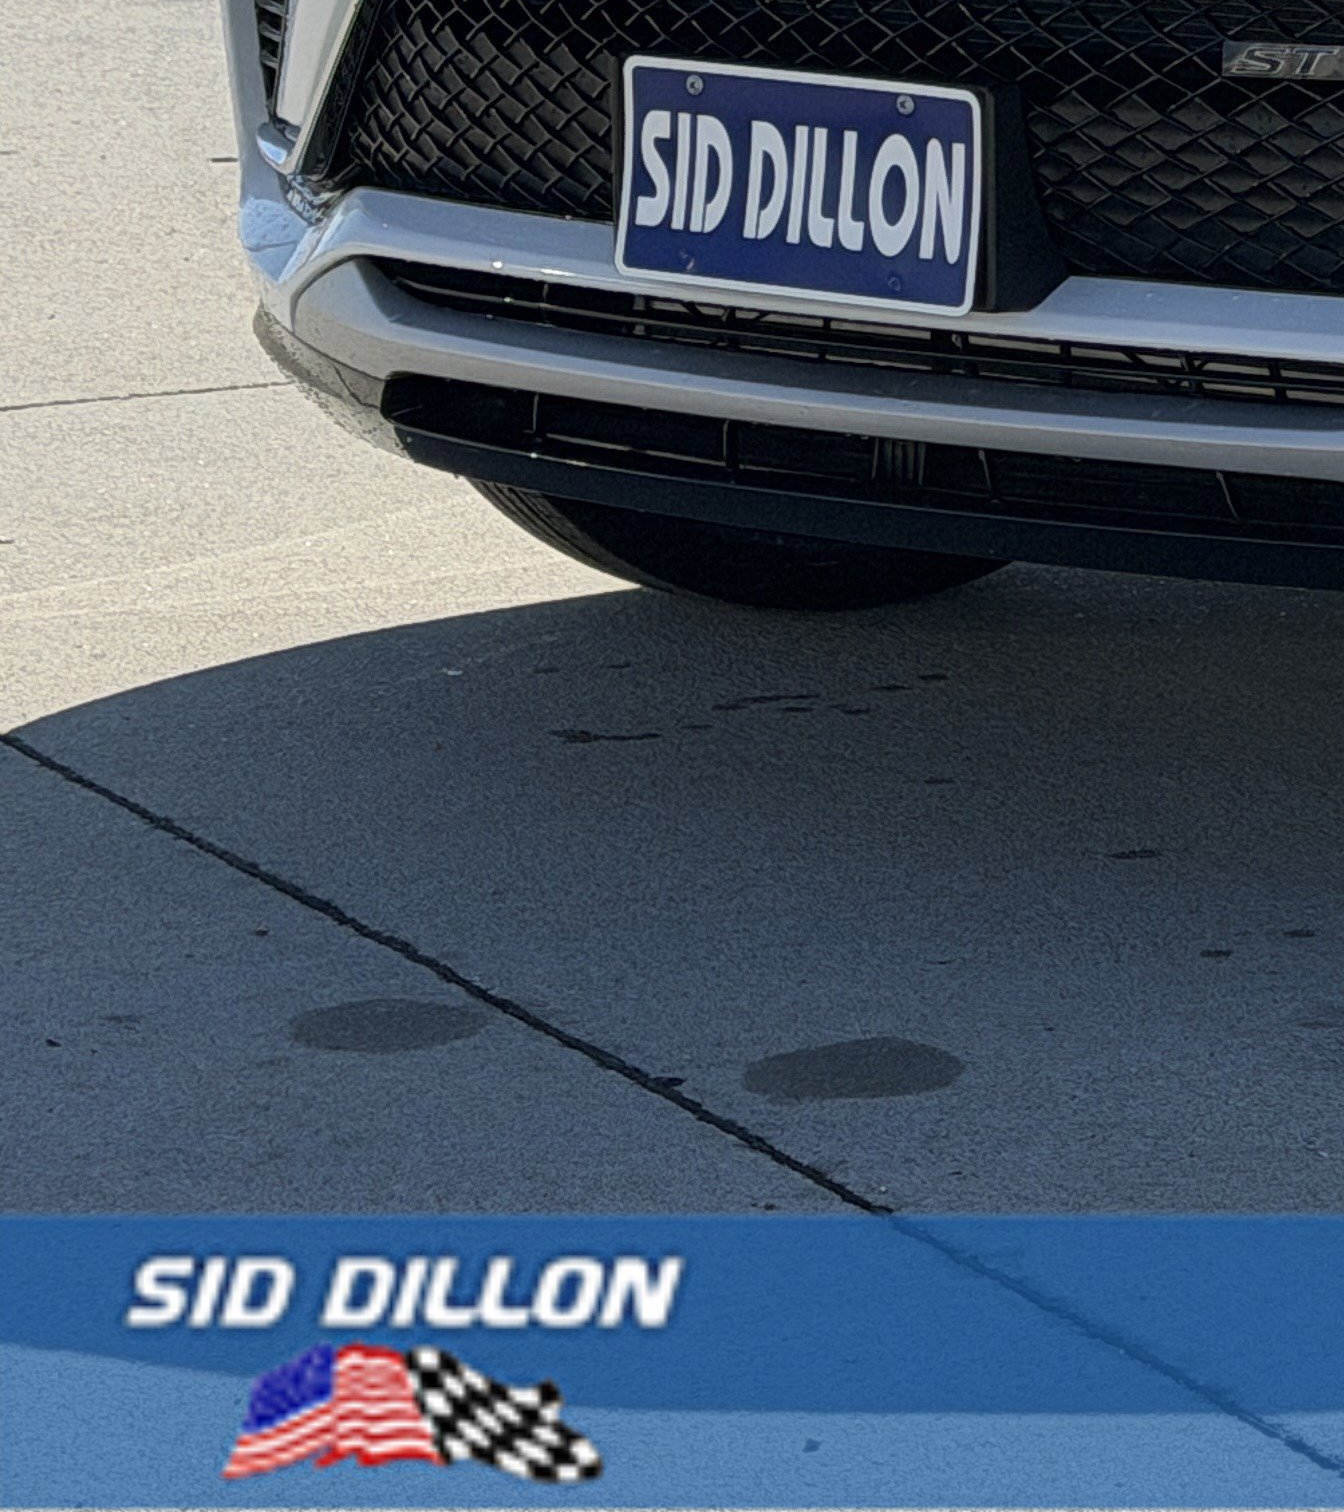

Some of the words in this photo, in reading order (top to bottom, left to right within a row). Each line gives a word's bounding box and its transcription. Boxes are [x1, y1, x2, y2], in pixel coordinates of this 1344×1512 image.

[1229, 45, 1342, 77] ST
[634, 109, 734, 234] SID
[742, 120, 966, 265] DILLON
